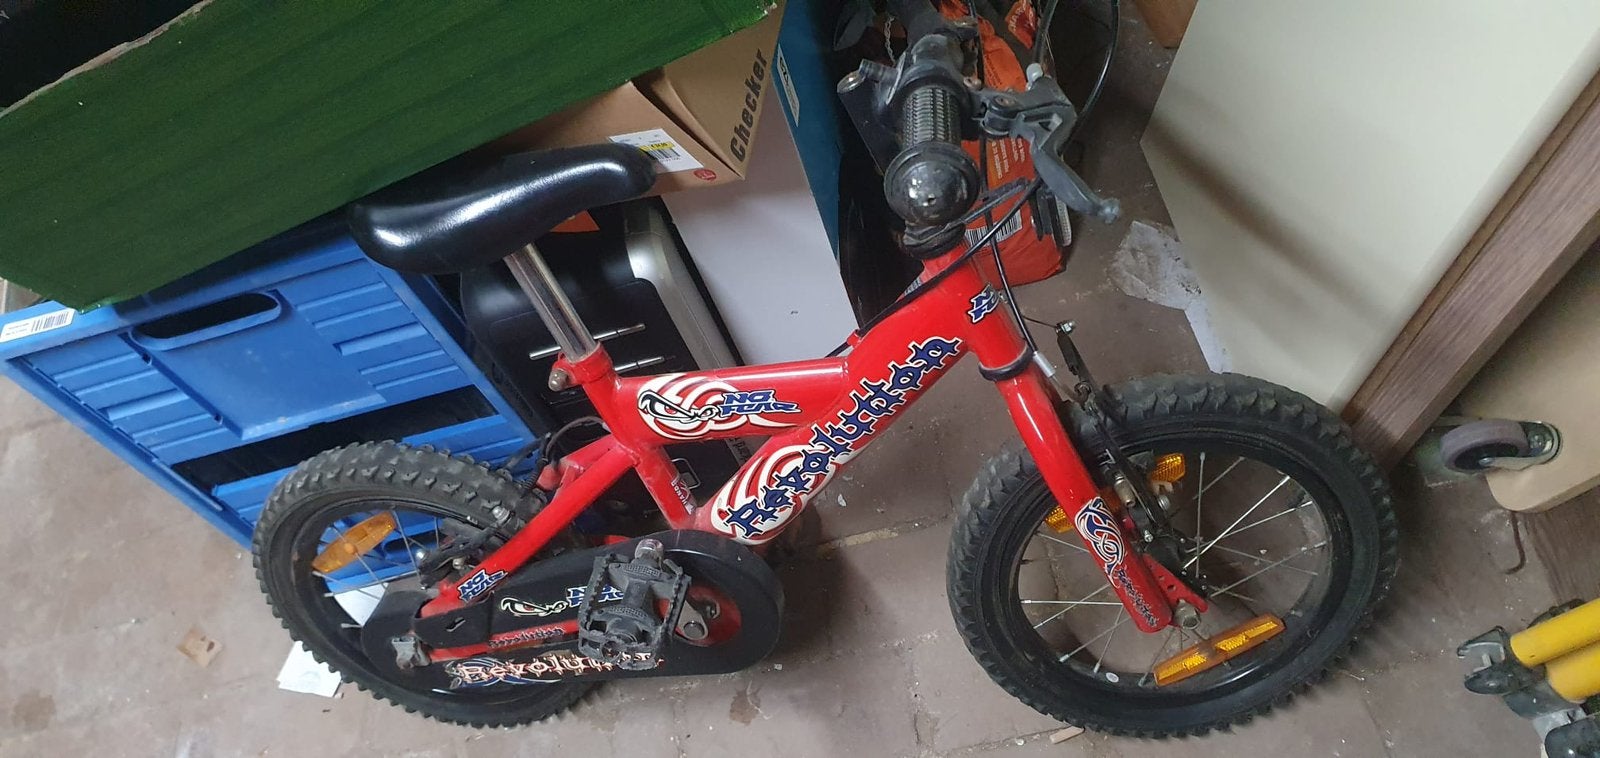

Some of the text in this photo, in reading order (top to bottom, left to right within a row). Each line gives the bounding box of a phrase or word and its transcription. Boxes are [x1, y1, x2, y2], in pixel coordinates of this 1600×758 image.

[730, 48, 768, 163] Checker
[722, 389, 777, 404] NO
[719, 401, 801, 417] FEAR
[725, 336, 962, 539] Revolution
[458, 570, 486, 594] NO
